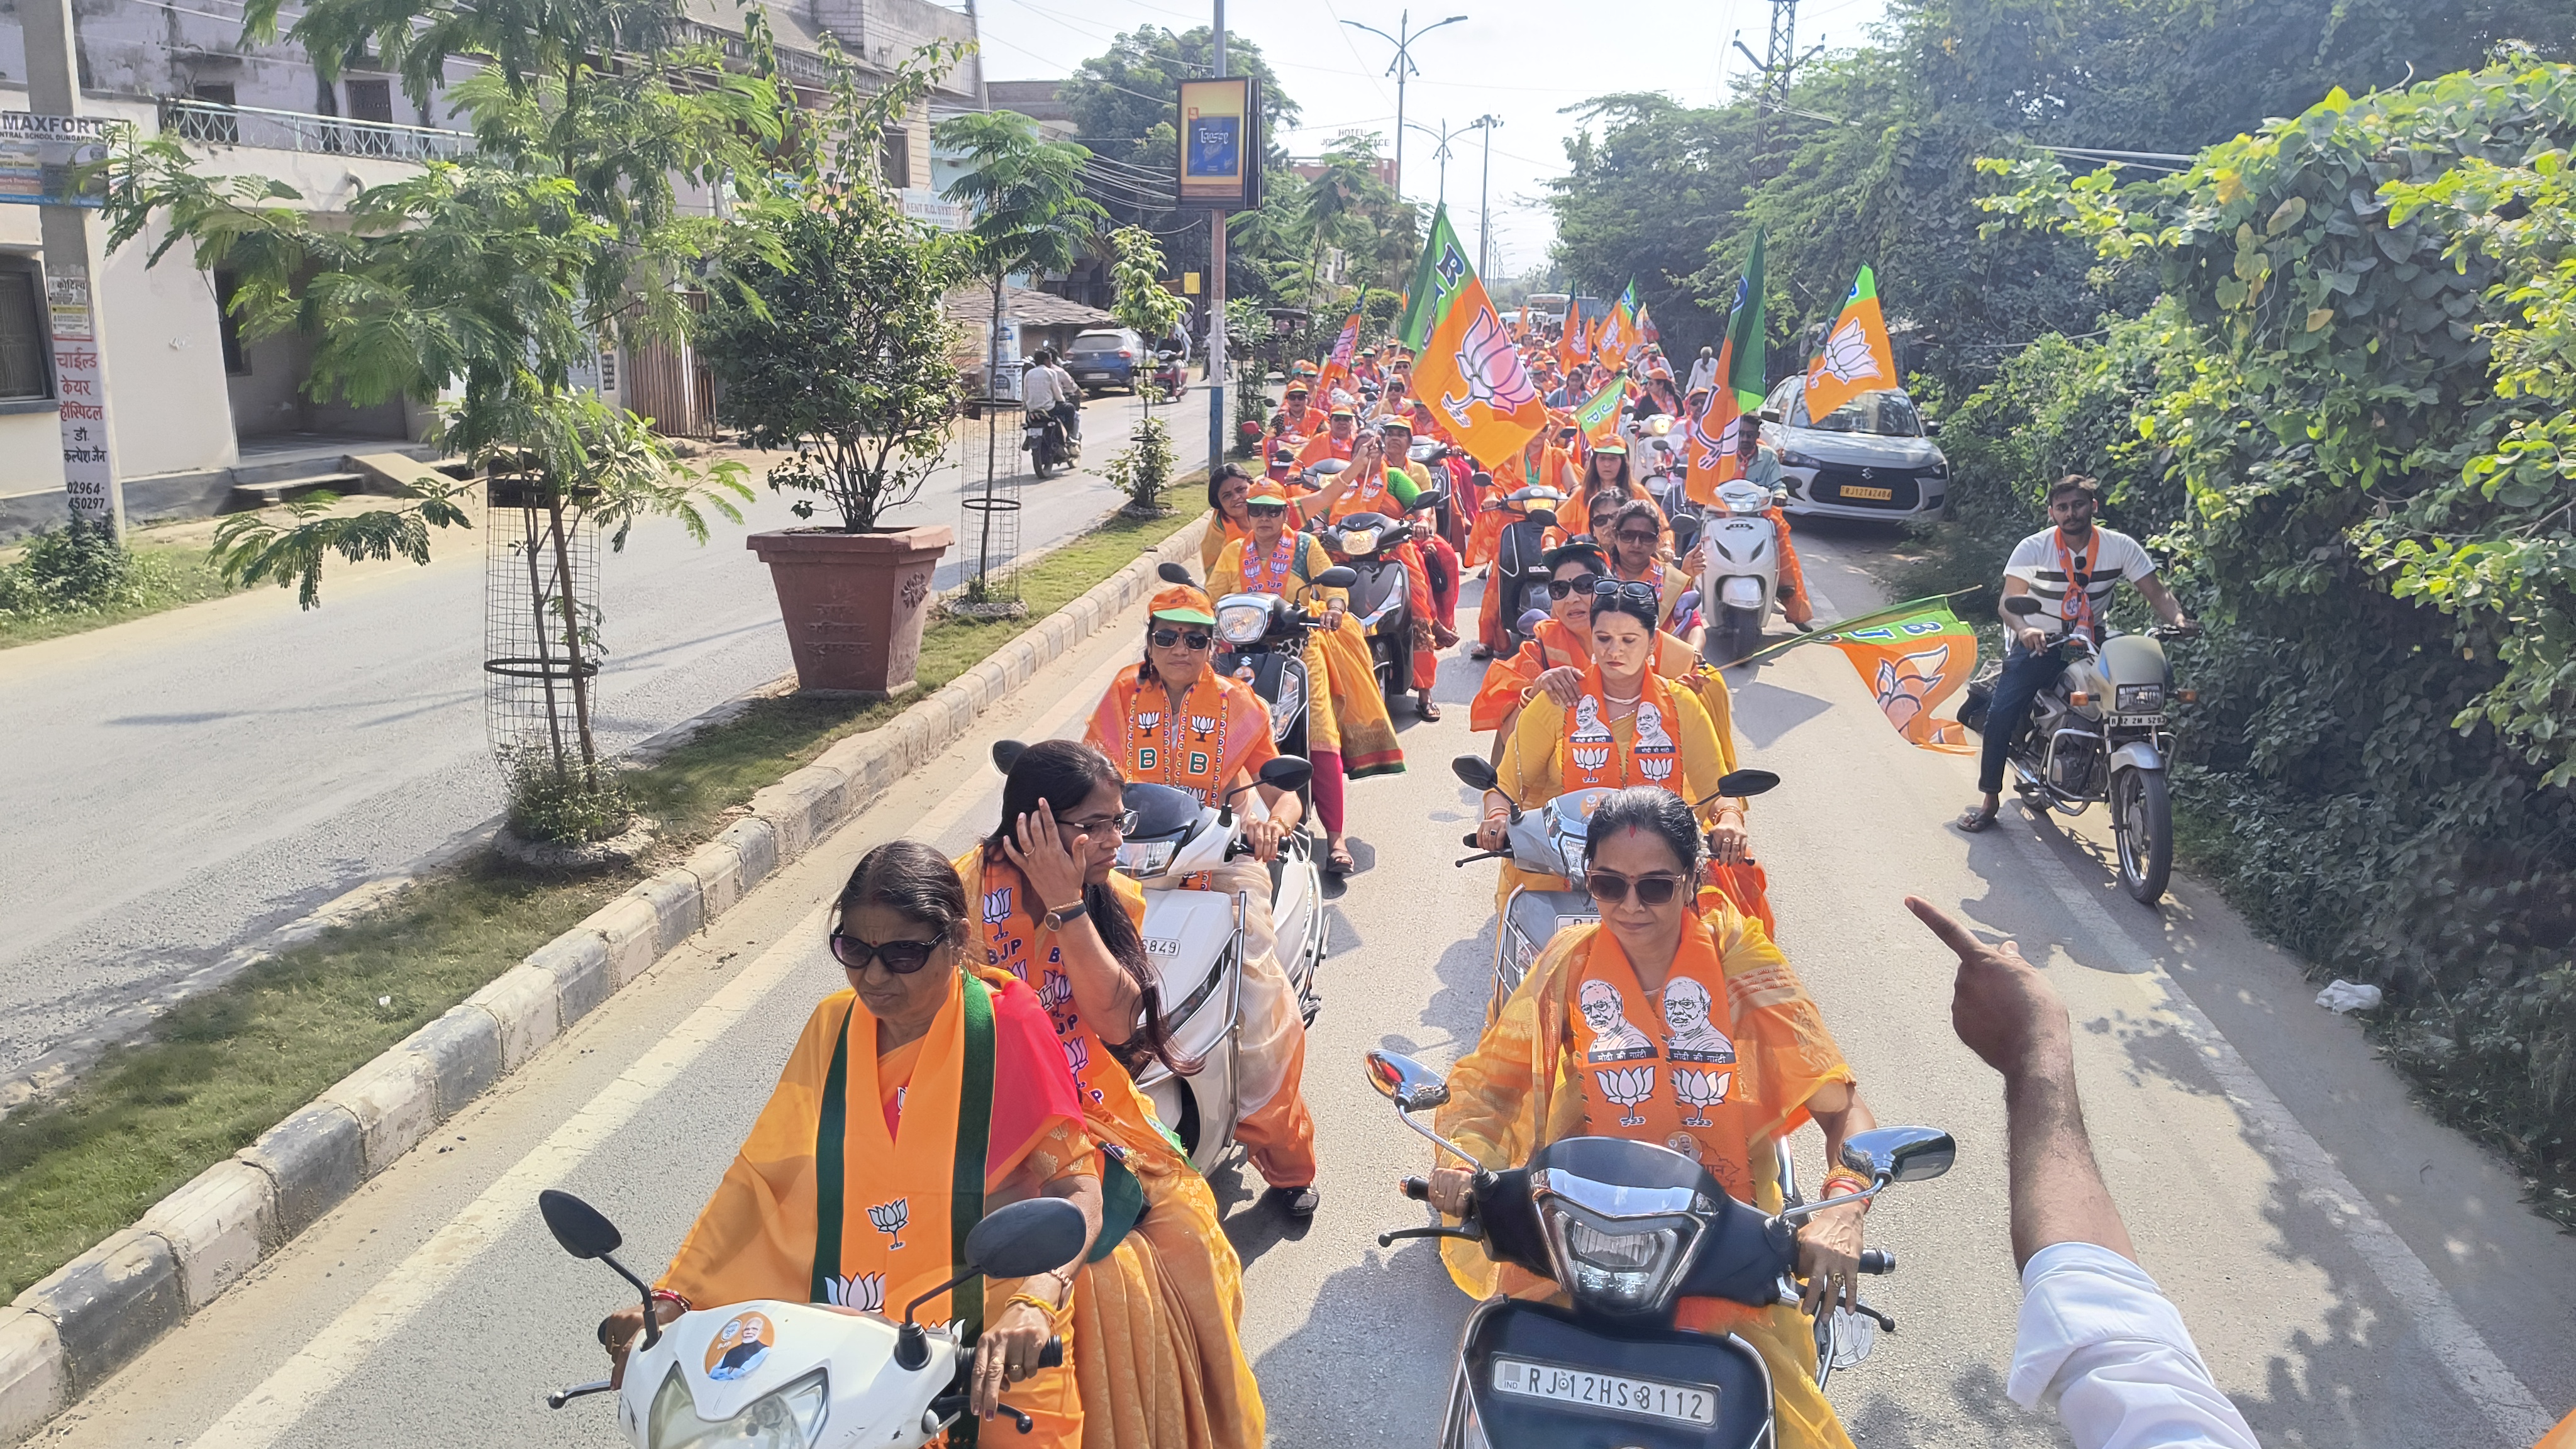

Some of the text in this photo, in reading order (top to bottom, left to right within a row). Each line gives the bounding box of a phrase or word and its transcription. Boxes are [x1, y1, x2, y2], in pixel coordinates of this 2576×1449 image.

[3, 114, 106, 136] MAXFORT
[25, 133, 53, 141] SCHOOL
[906, 203, 923, 213] KENT
[55, 347, 97, 371] चाईल्ड
[60, 374, 91, 396] केयर
[92, 445, 107, 462] जैन
[69, 497, 104, 509] 450297
[1244, 557, 1259, 566] BJP
[1272, 552, 1289, 560] BJP
[1247, 583, 1263, 592] BJP
[1139, 748, 1157, 770] B
[1188, 751, 1209, 774] B
[987, 938, 1023, 965] BJP
[1055, 1014, 1079, 1035] JP
[1597, 1050, 1646, 1062] मोदी की गारंटी
[1674, 1051, 1726, 1063] मोदी की गारंटी
[1504, 1381, 1518, 1389] IND
